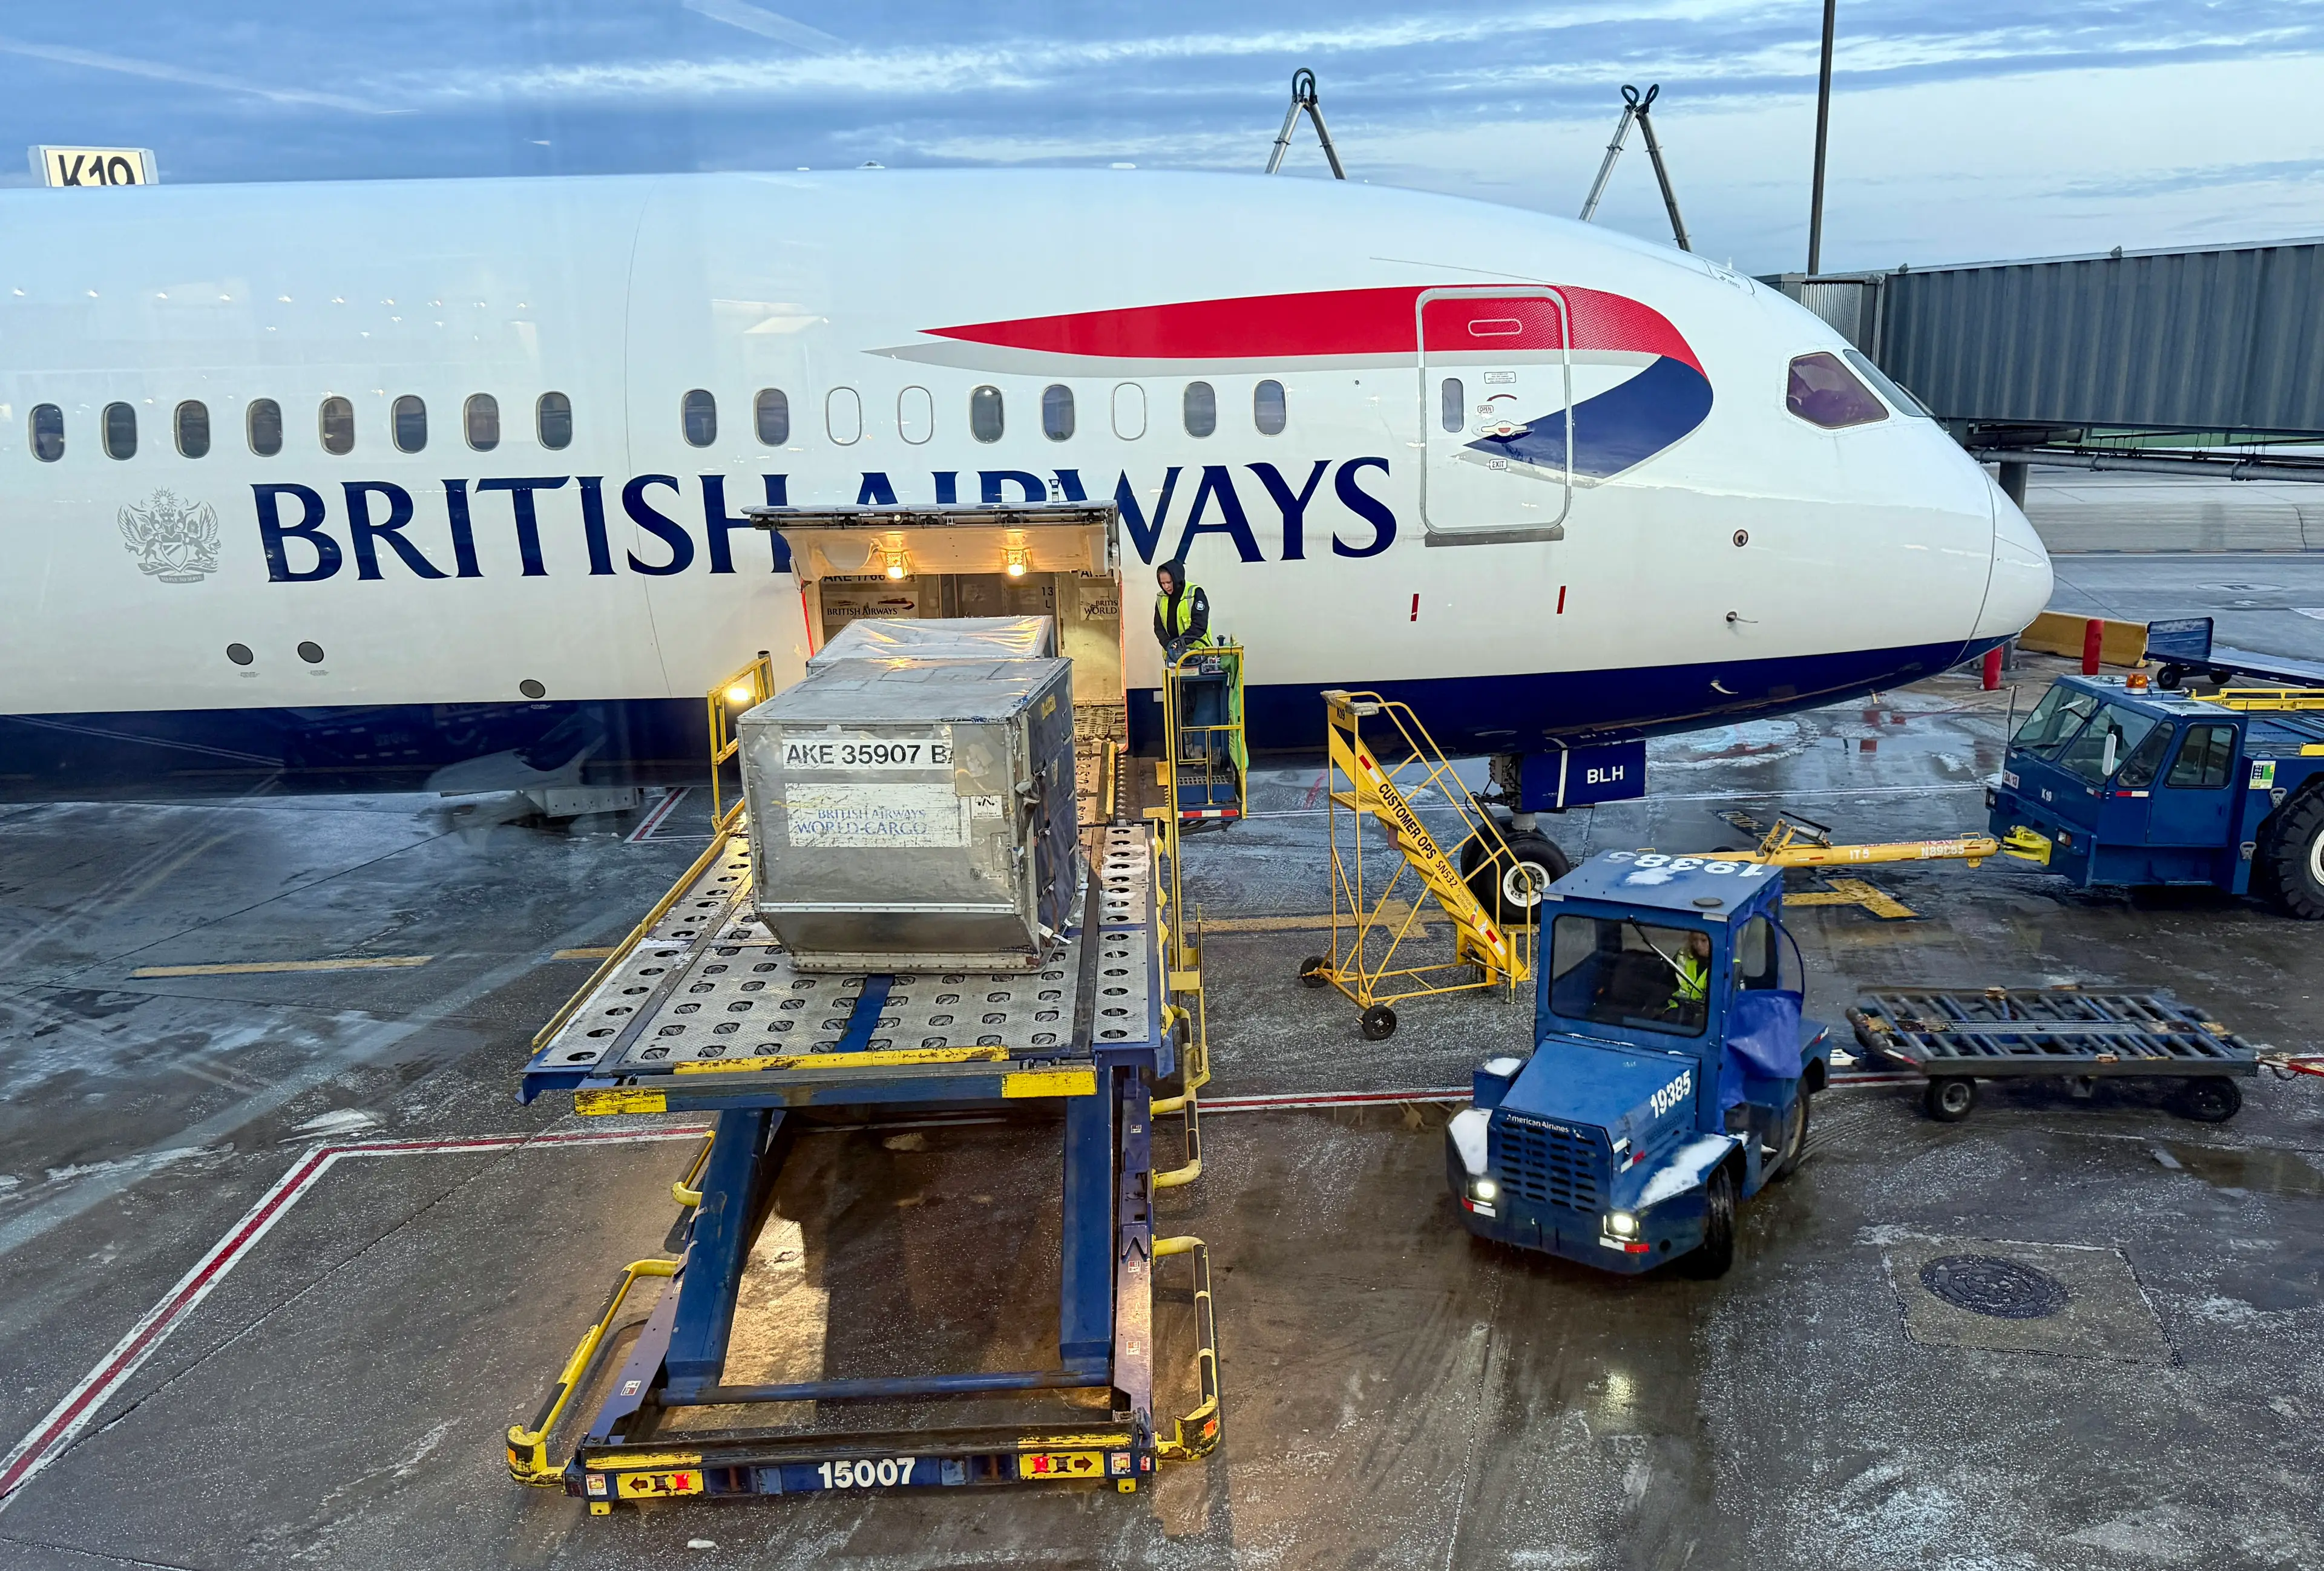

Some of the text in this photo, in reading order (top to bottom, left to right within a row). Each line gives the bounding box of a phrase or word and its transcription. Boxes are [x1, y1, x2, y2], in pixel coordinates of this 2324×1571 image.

[250, 473, 792, 583] BRITISH
[1042, 586, 1054, 596] 13
[1084, 606, 1117, 615] WORLD
[786, 744, 834, 764] AKE
[842, 744, 921, 764] 35907
[1587, 766, 1624, 784] BLH
[818, 809, 926, 819] BRITISH AIRWAYS
[1379, 784, 1458, 888] CUSTOMER OPS SN532
[1603, 851, 1763, 877] 19385
[1850, 850, 1860, 860] IT
[1456, 894, 1469, 911] Airlines
[1457, 887, 1473, 908] American
[1650, 1069, 1691, 1118] 19385
[1506, 1114, 1541, 1127] American
[818, 1457, 916, 1489] 15007
